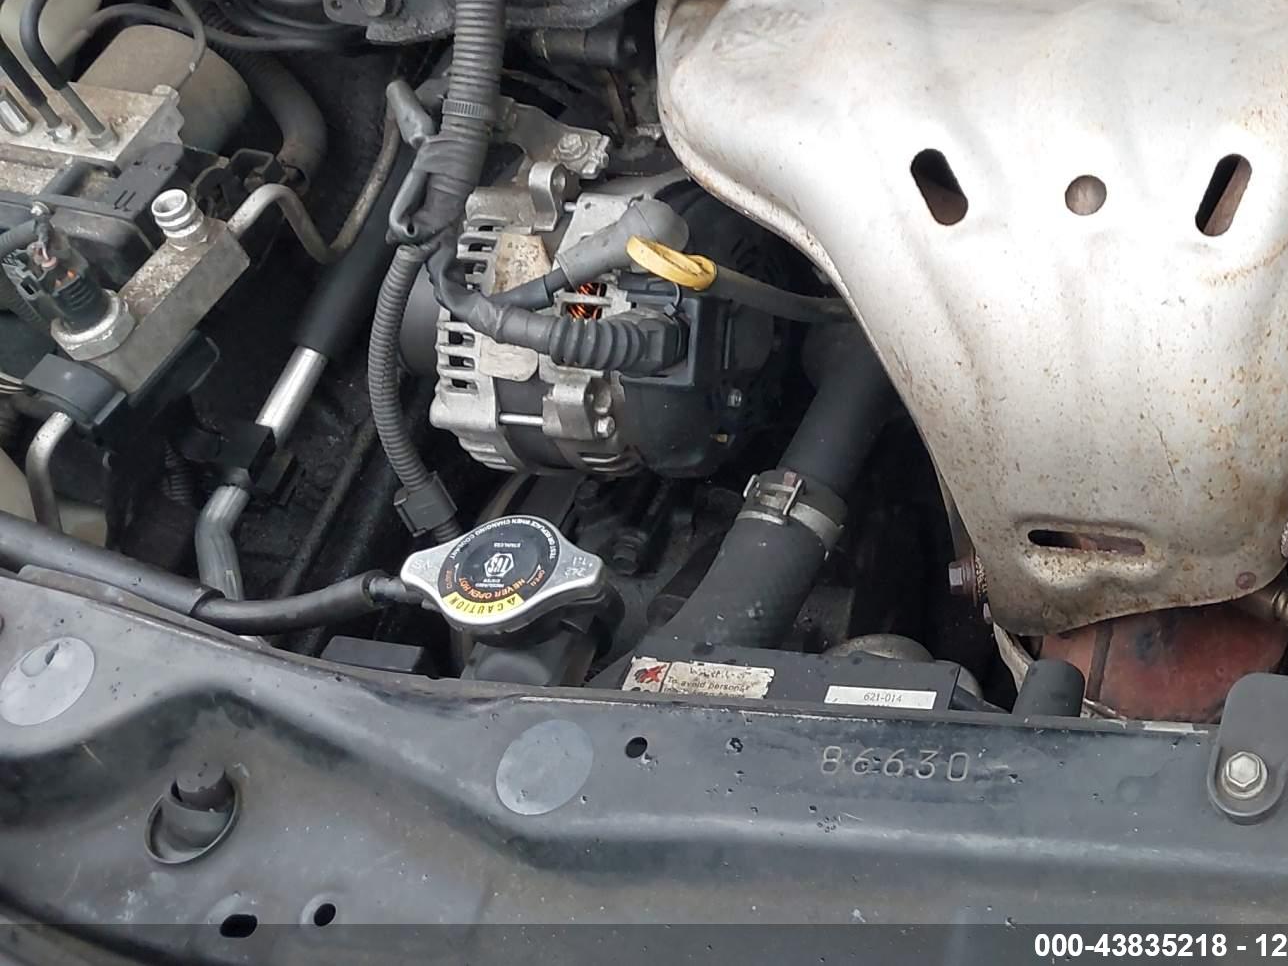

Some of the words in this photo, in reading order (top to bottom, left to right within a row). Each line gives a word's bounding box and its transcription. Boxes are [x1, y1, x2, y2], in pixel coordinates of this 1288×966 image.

[511, 518, 530, 526] WHEN
[469, 585, 492, 600] OPEN
[494, 577, 525, 598] NEVER
[449, 596, 504, 615] CAUTION
[863, 691, 903, 703] 621-014
[820, 744, 971, 783] 86630
